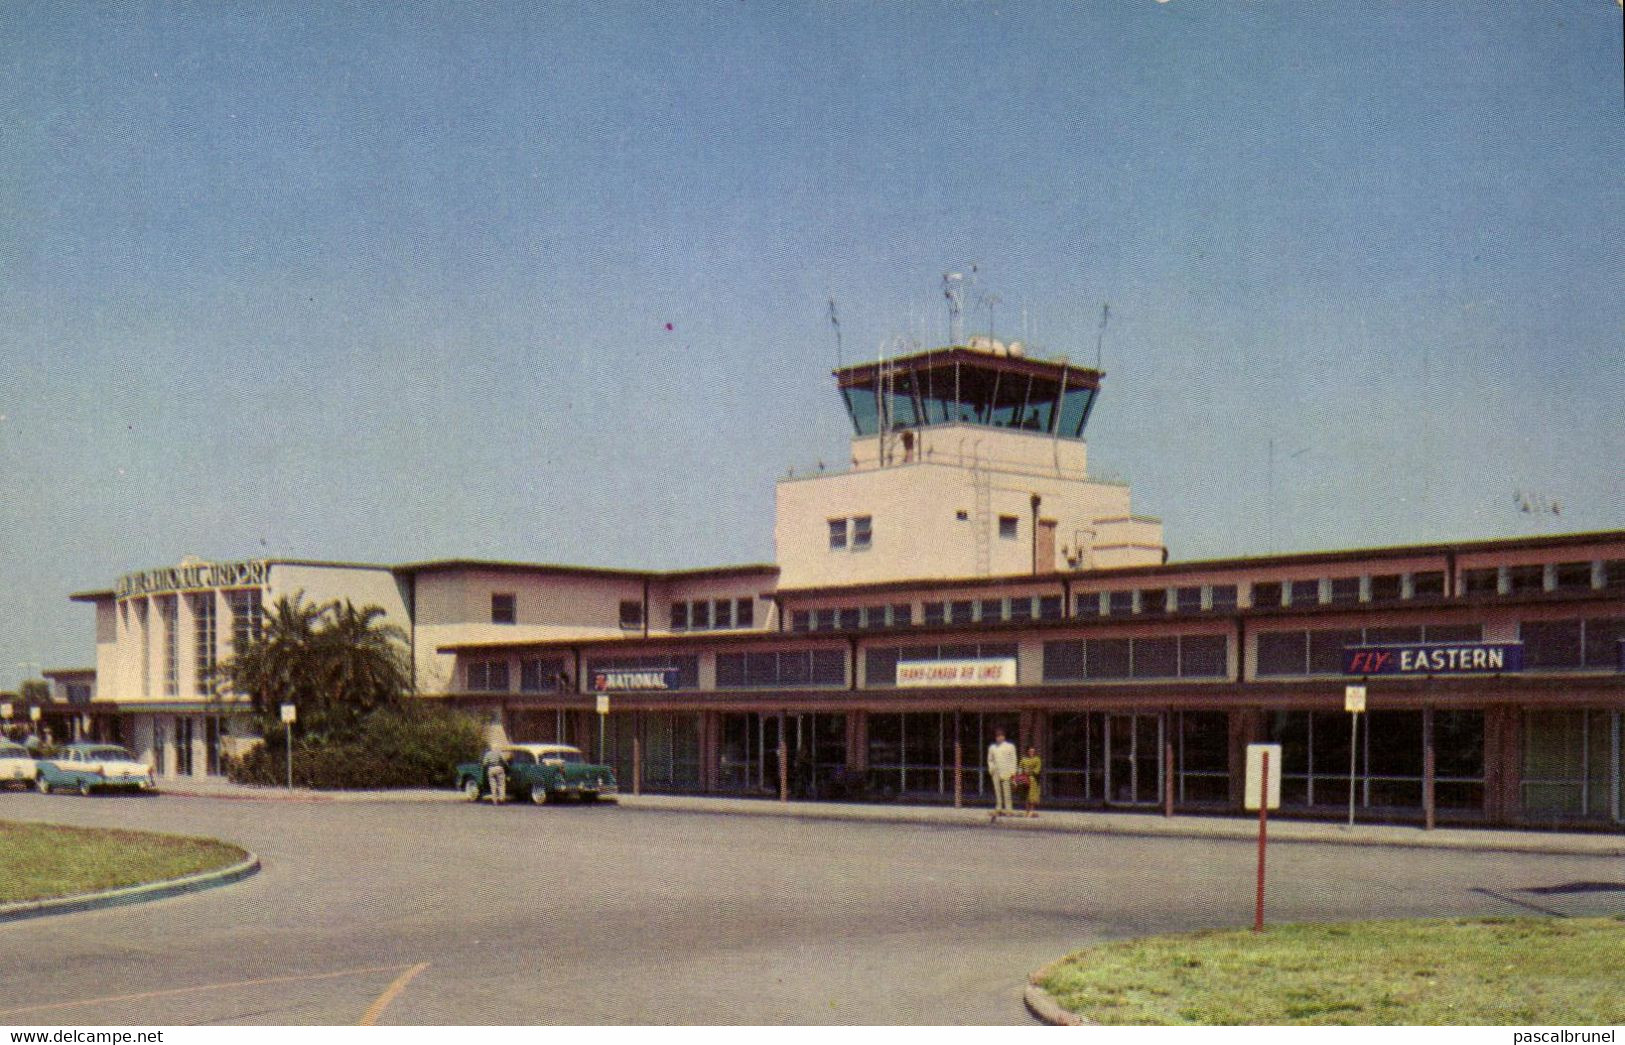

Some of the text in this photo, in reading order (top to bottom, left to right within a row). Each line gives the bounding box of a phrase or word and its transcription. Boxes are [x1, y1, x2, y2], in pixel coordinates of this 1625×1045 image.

[205, 559, 269, 588] AIRPORT
[1400, 648, 1504, 671] EASTERN
[606, 672, 668, 689] NATIONAL
